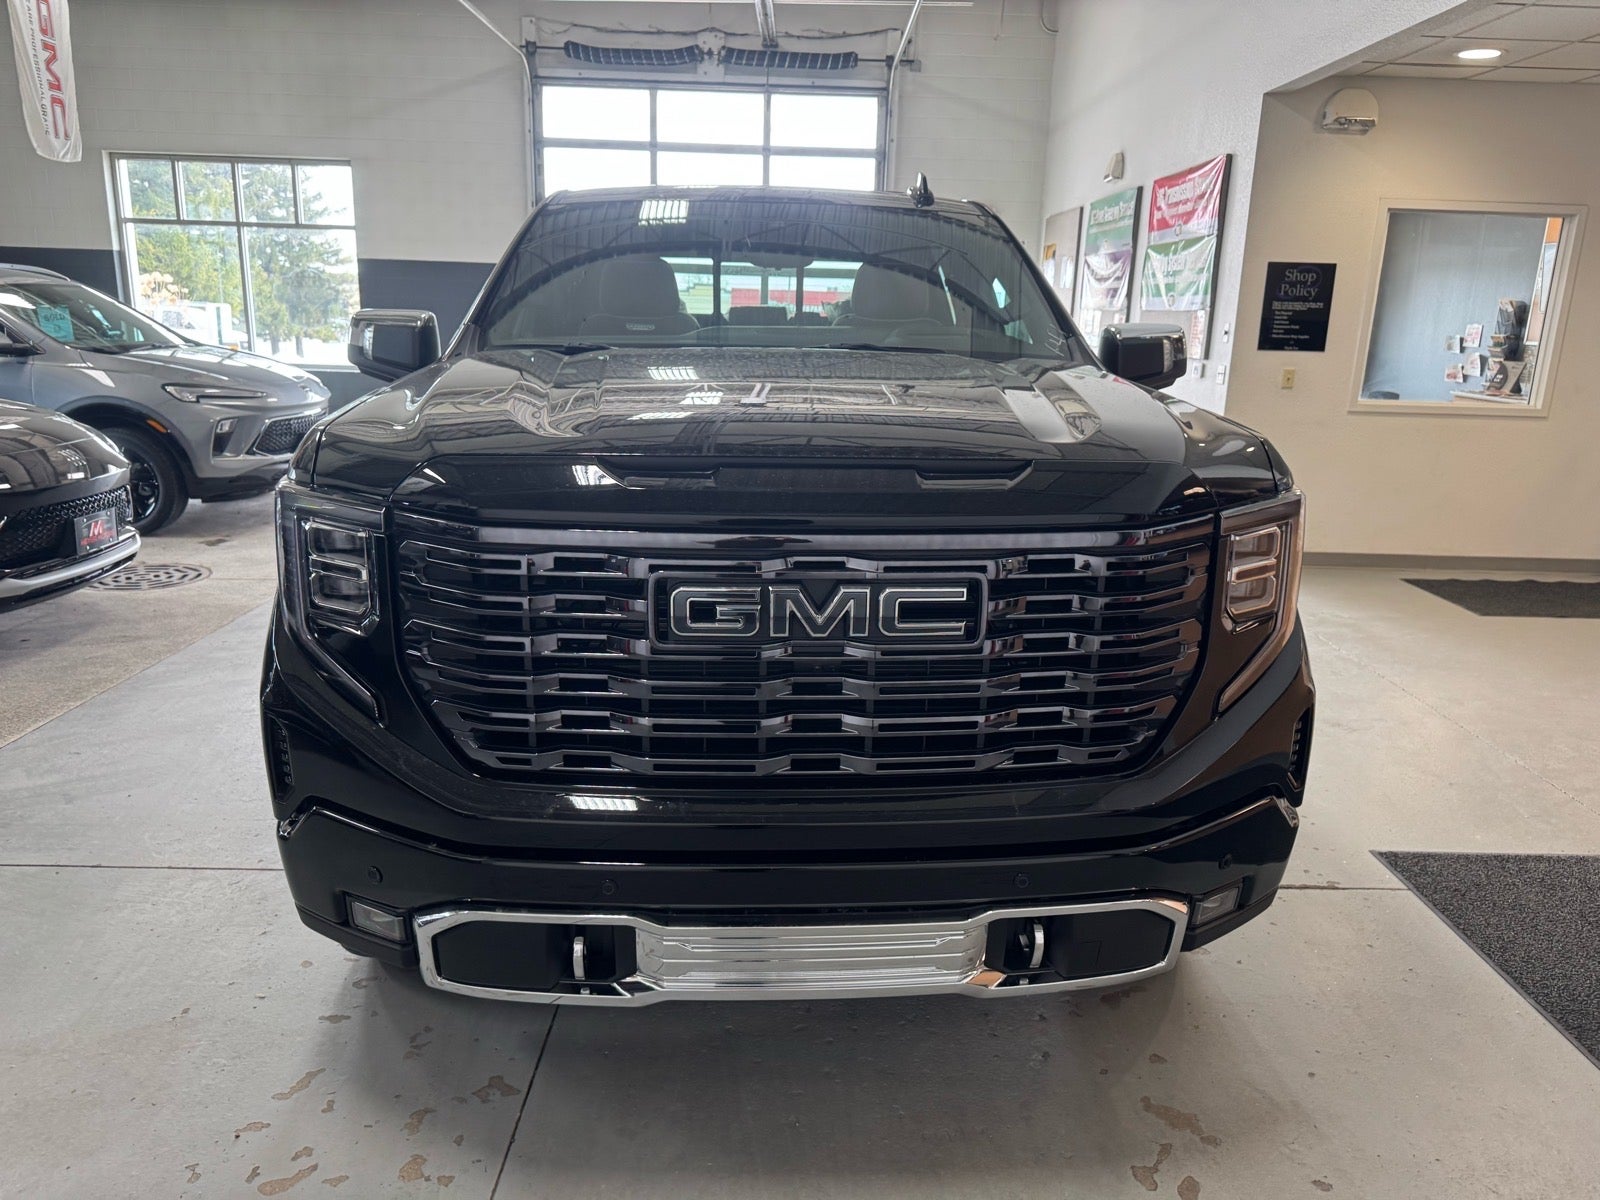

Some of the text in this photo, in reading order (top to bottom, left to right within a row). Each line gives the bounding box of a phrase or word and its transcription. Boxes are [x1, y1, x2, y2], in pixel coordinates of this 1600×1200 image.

[36, 0, 72, 141] GMC
[1280, 284, 1319, 301] Policy
[1285, 268, 1317, 286] Shop
[670, 586, 968, 638] GMC
